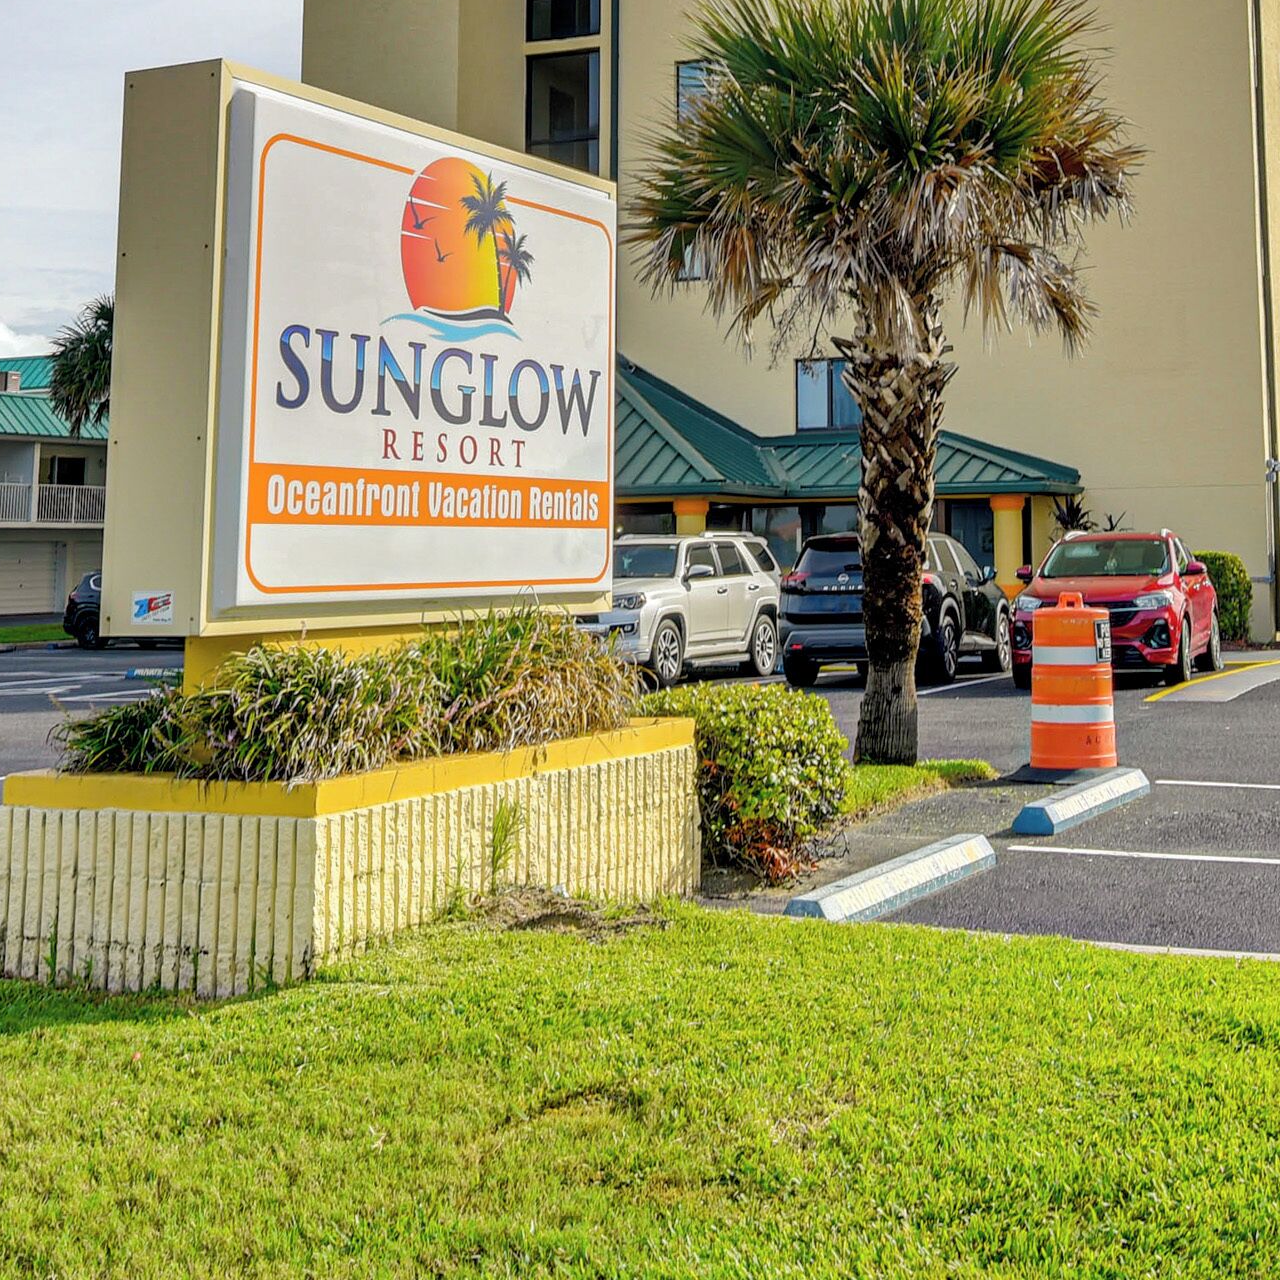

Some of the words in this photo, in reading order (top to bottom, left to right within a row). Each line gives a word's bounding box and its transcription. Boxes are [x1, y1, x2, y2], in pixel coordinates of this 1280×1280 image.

[276, 324, 602, 437] SUNGLOW
[381, 428, 526, 468] RESORT
[267, 474, 420, 517] Oceanfront
[428, 481, 522, 520] Vacation
[529, 486, 599, 521] Rentals
